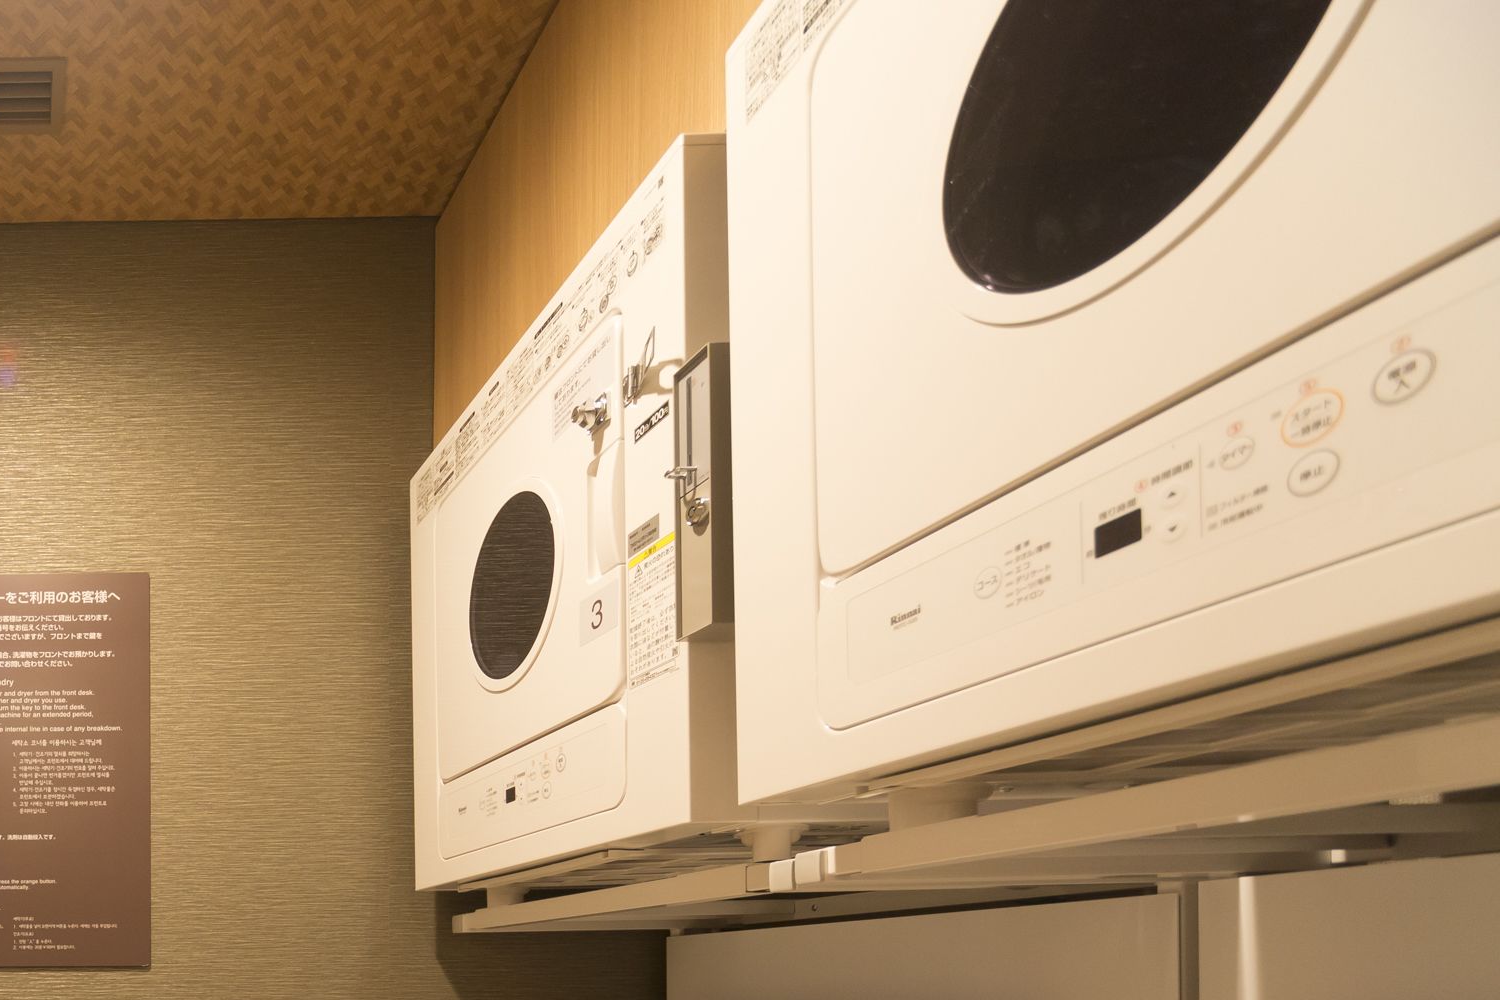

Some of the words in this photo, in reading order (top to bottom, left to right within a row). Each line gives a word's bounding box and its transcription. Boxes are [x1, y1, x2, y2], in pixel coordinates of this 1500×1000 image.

[976, 575, 998, 591] コース
[591, 599, 603, 630] 3
